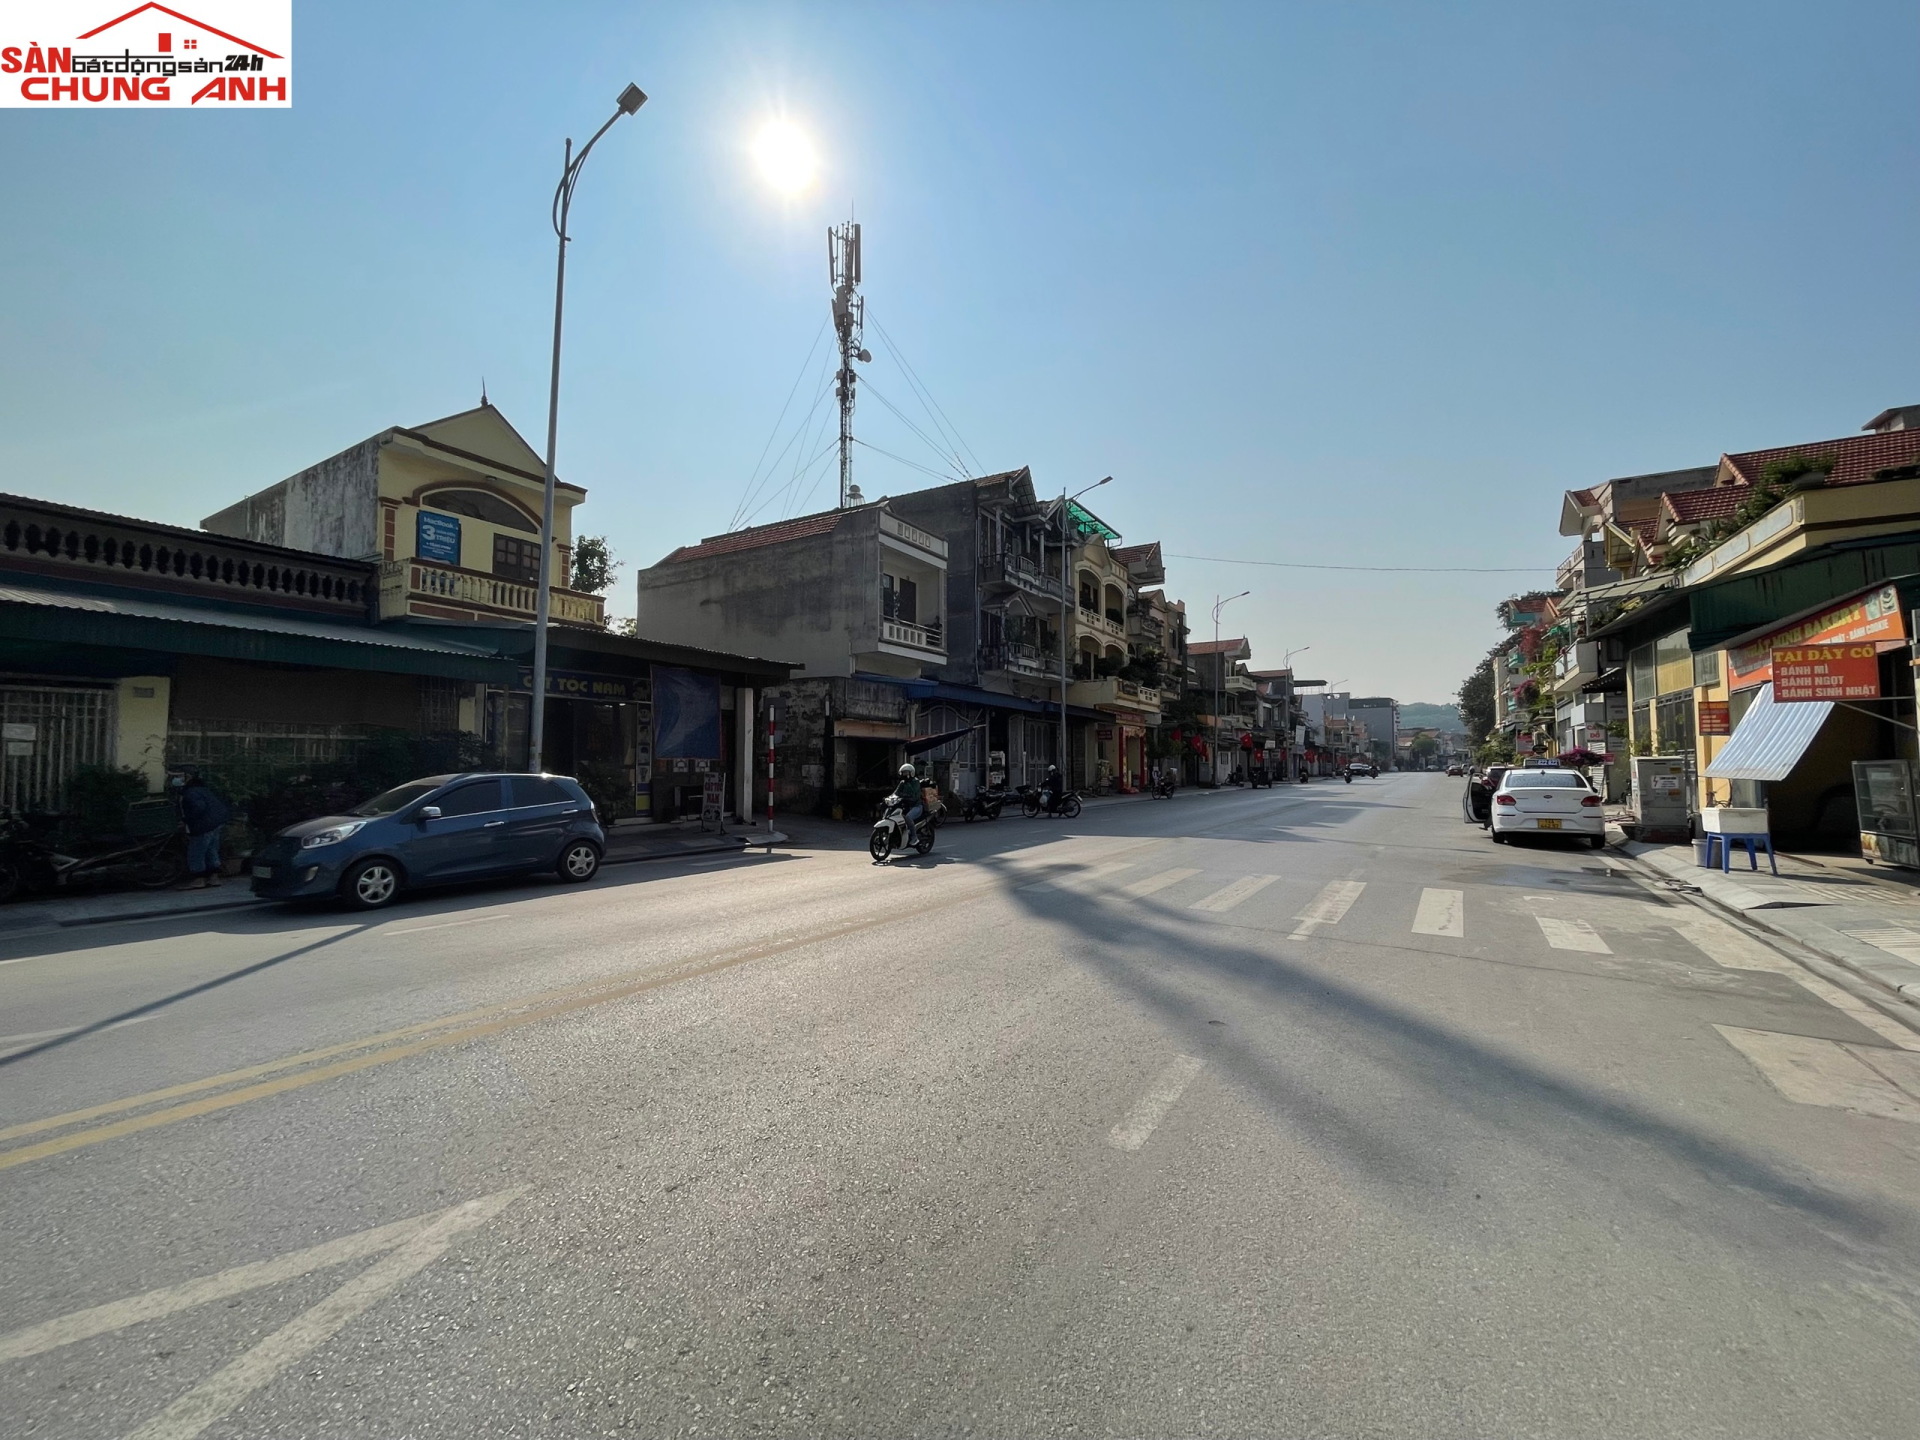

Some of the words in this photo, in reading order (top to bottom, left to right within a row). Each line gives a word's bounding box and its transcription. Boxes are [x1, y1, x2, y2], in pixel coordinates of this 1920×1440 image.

[423, 516, 454, 528] MacBook
[422, 524, 435, 540] 3
[1773, 626, 1802, 646] MINH
[1804, 603, 1861, 638] BAKERY
[1849, 626, 1866, 640] BÁNH
[1866, 619, 1889, 634] COOKIE
[1773, 650, 1802, 664] TẠI
[1807, 647, 1845, 660] ĐÂY
[1814, 663, 1829, 675] MÌ
[523, 674, 552, 690] CT
[558, 676, 589, 693] TÓC
[592, 680, 627, 697] NAM
[1815, 675, 1844, 687] NGỌT
[1815, 687, 1843, 697] SINH
[1846, 684, 1876, 697] NHẬT
